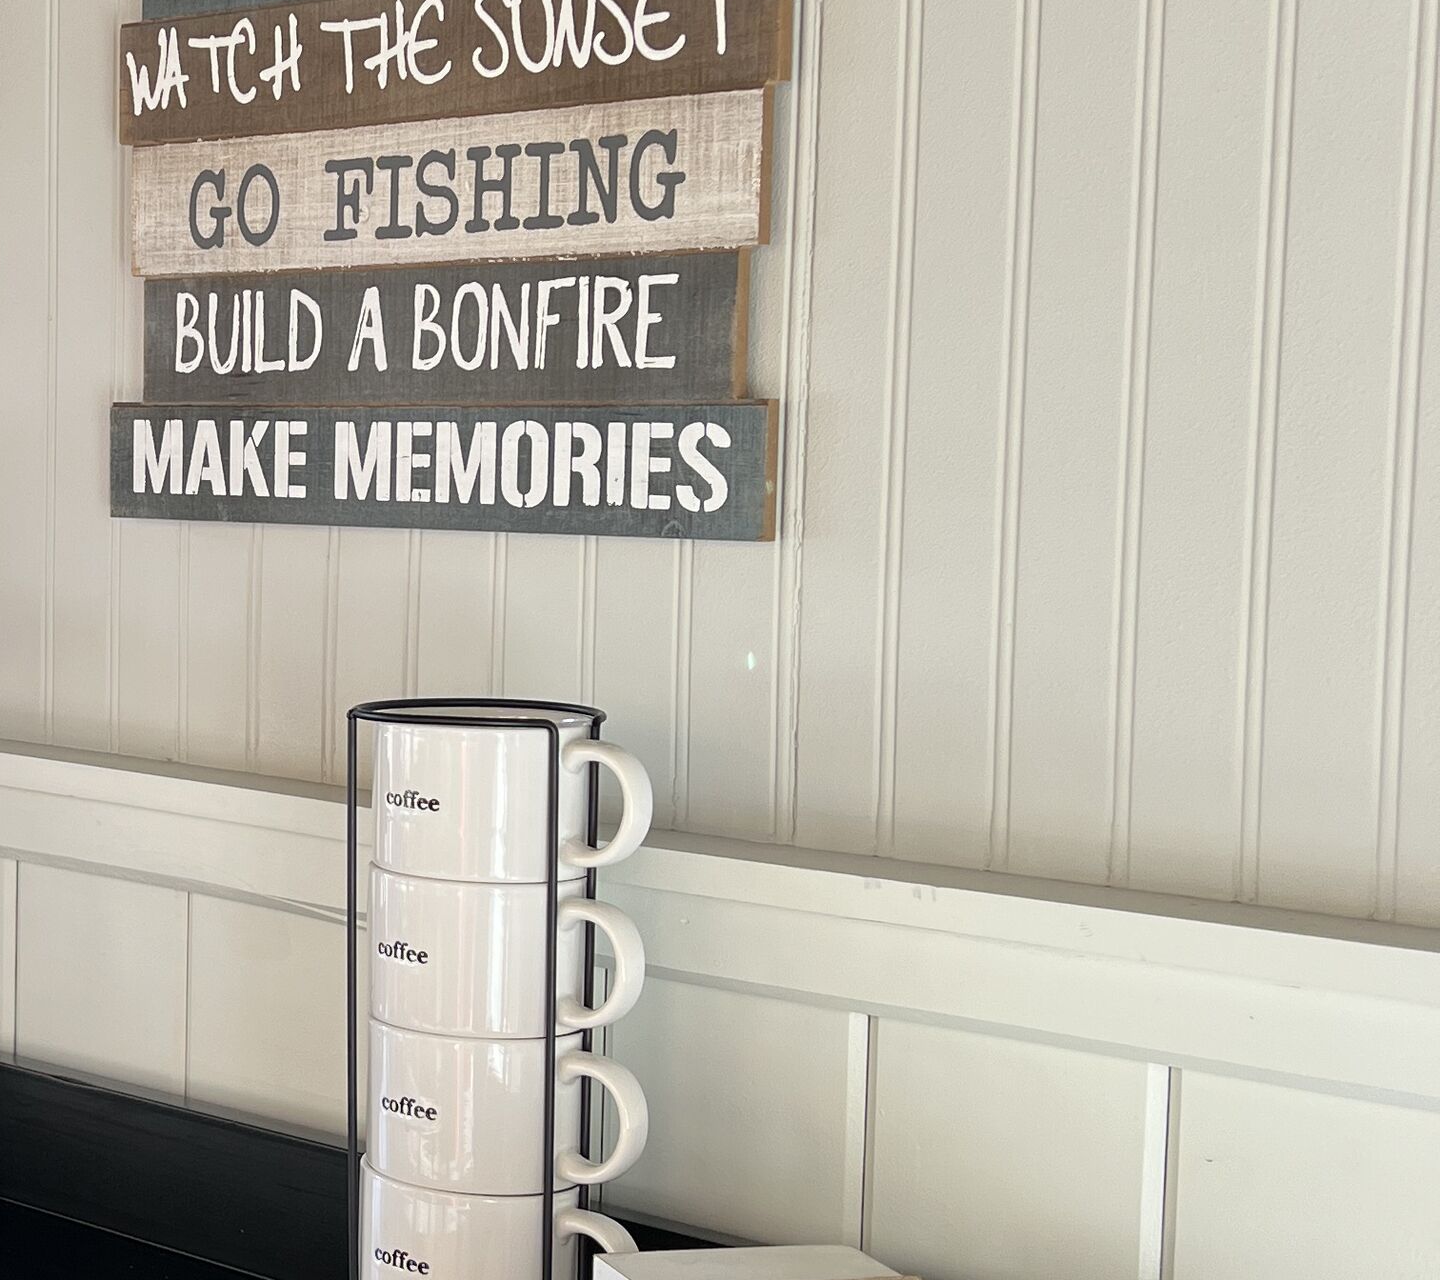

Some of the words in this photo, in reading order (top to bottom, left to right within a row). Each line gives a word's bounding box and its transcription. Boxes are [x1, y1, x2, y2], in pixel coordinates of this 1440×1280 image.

[126, 13, 302, 116] WATCH
[188, 163, 281, 251] GO
[322, 128, 686, 242] FISHING
[175, 291, 323, 375] BUILD
[347, 286, 388, 373] A
[411, 273, 680, 372] BONFIRE
[131, 419, 307, 500] MAKE
[332, 420, 732, 513] MEMORIES
[385, 789, 441, 813] coffee
[377, 939, 429, 965] coffee
[381, 1094, 438, 1122] coffee
[375, 1245, 430, 1275] coffee
